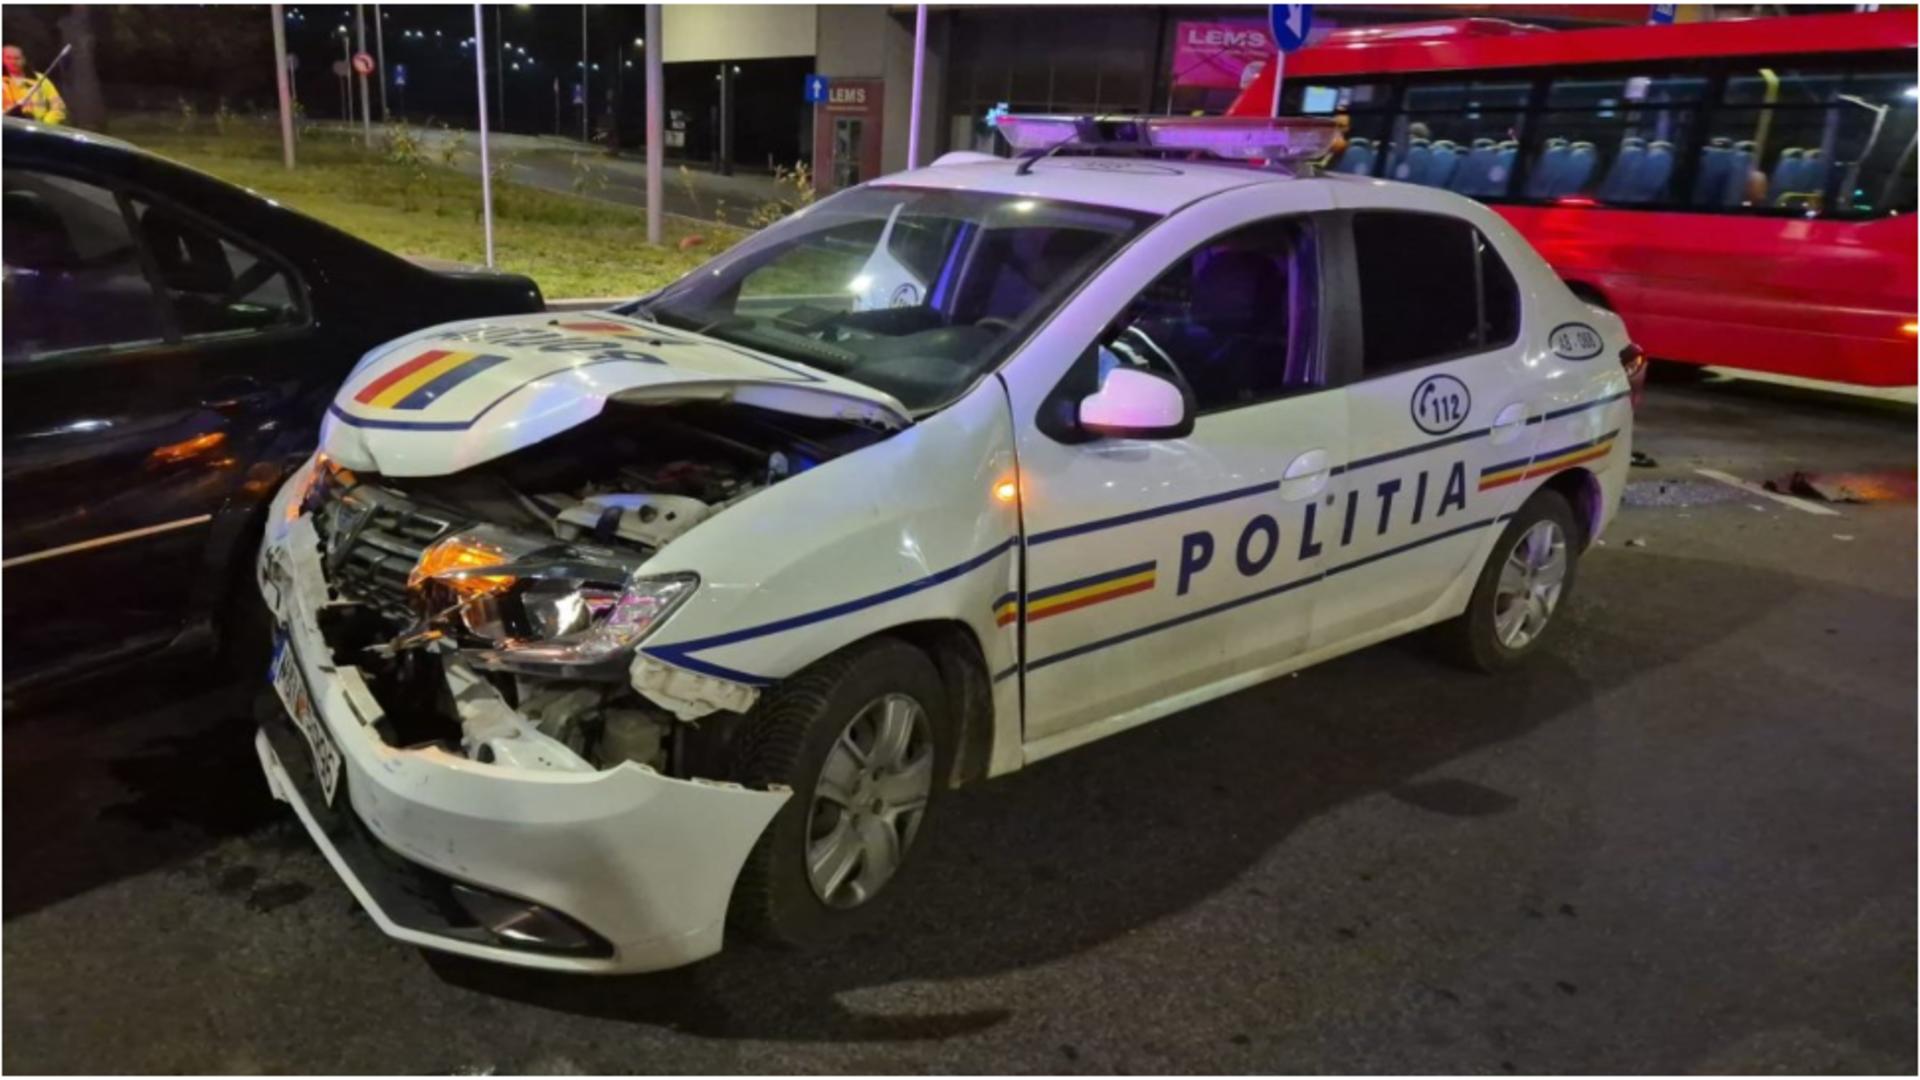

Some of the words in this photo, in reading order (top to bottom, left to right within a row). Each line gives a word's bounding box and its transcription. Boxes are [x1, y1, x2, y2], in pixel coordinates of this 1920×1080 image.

[1188, 29, 1266, 47] LEMS
[829, 88, 866, 103] LEMS
[1432, 394, 1460, 424] 112
[1177, 461, 1466, 596] POLITIA
